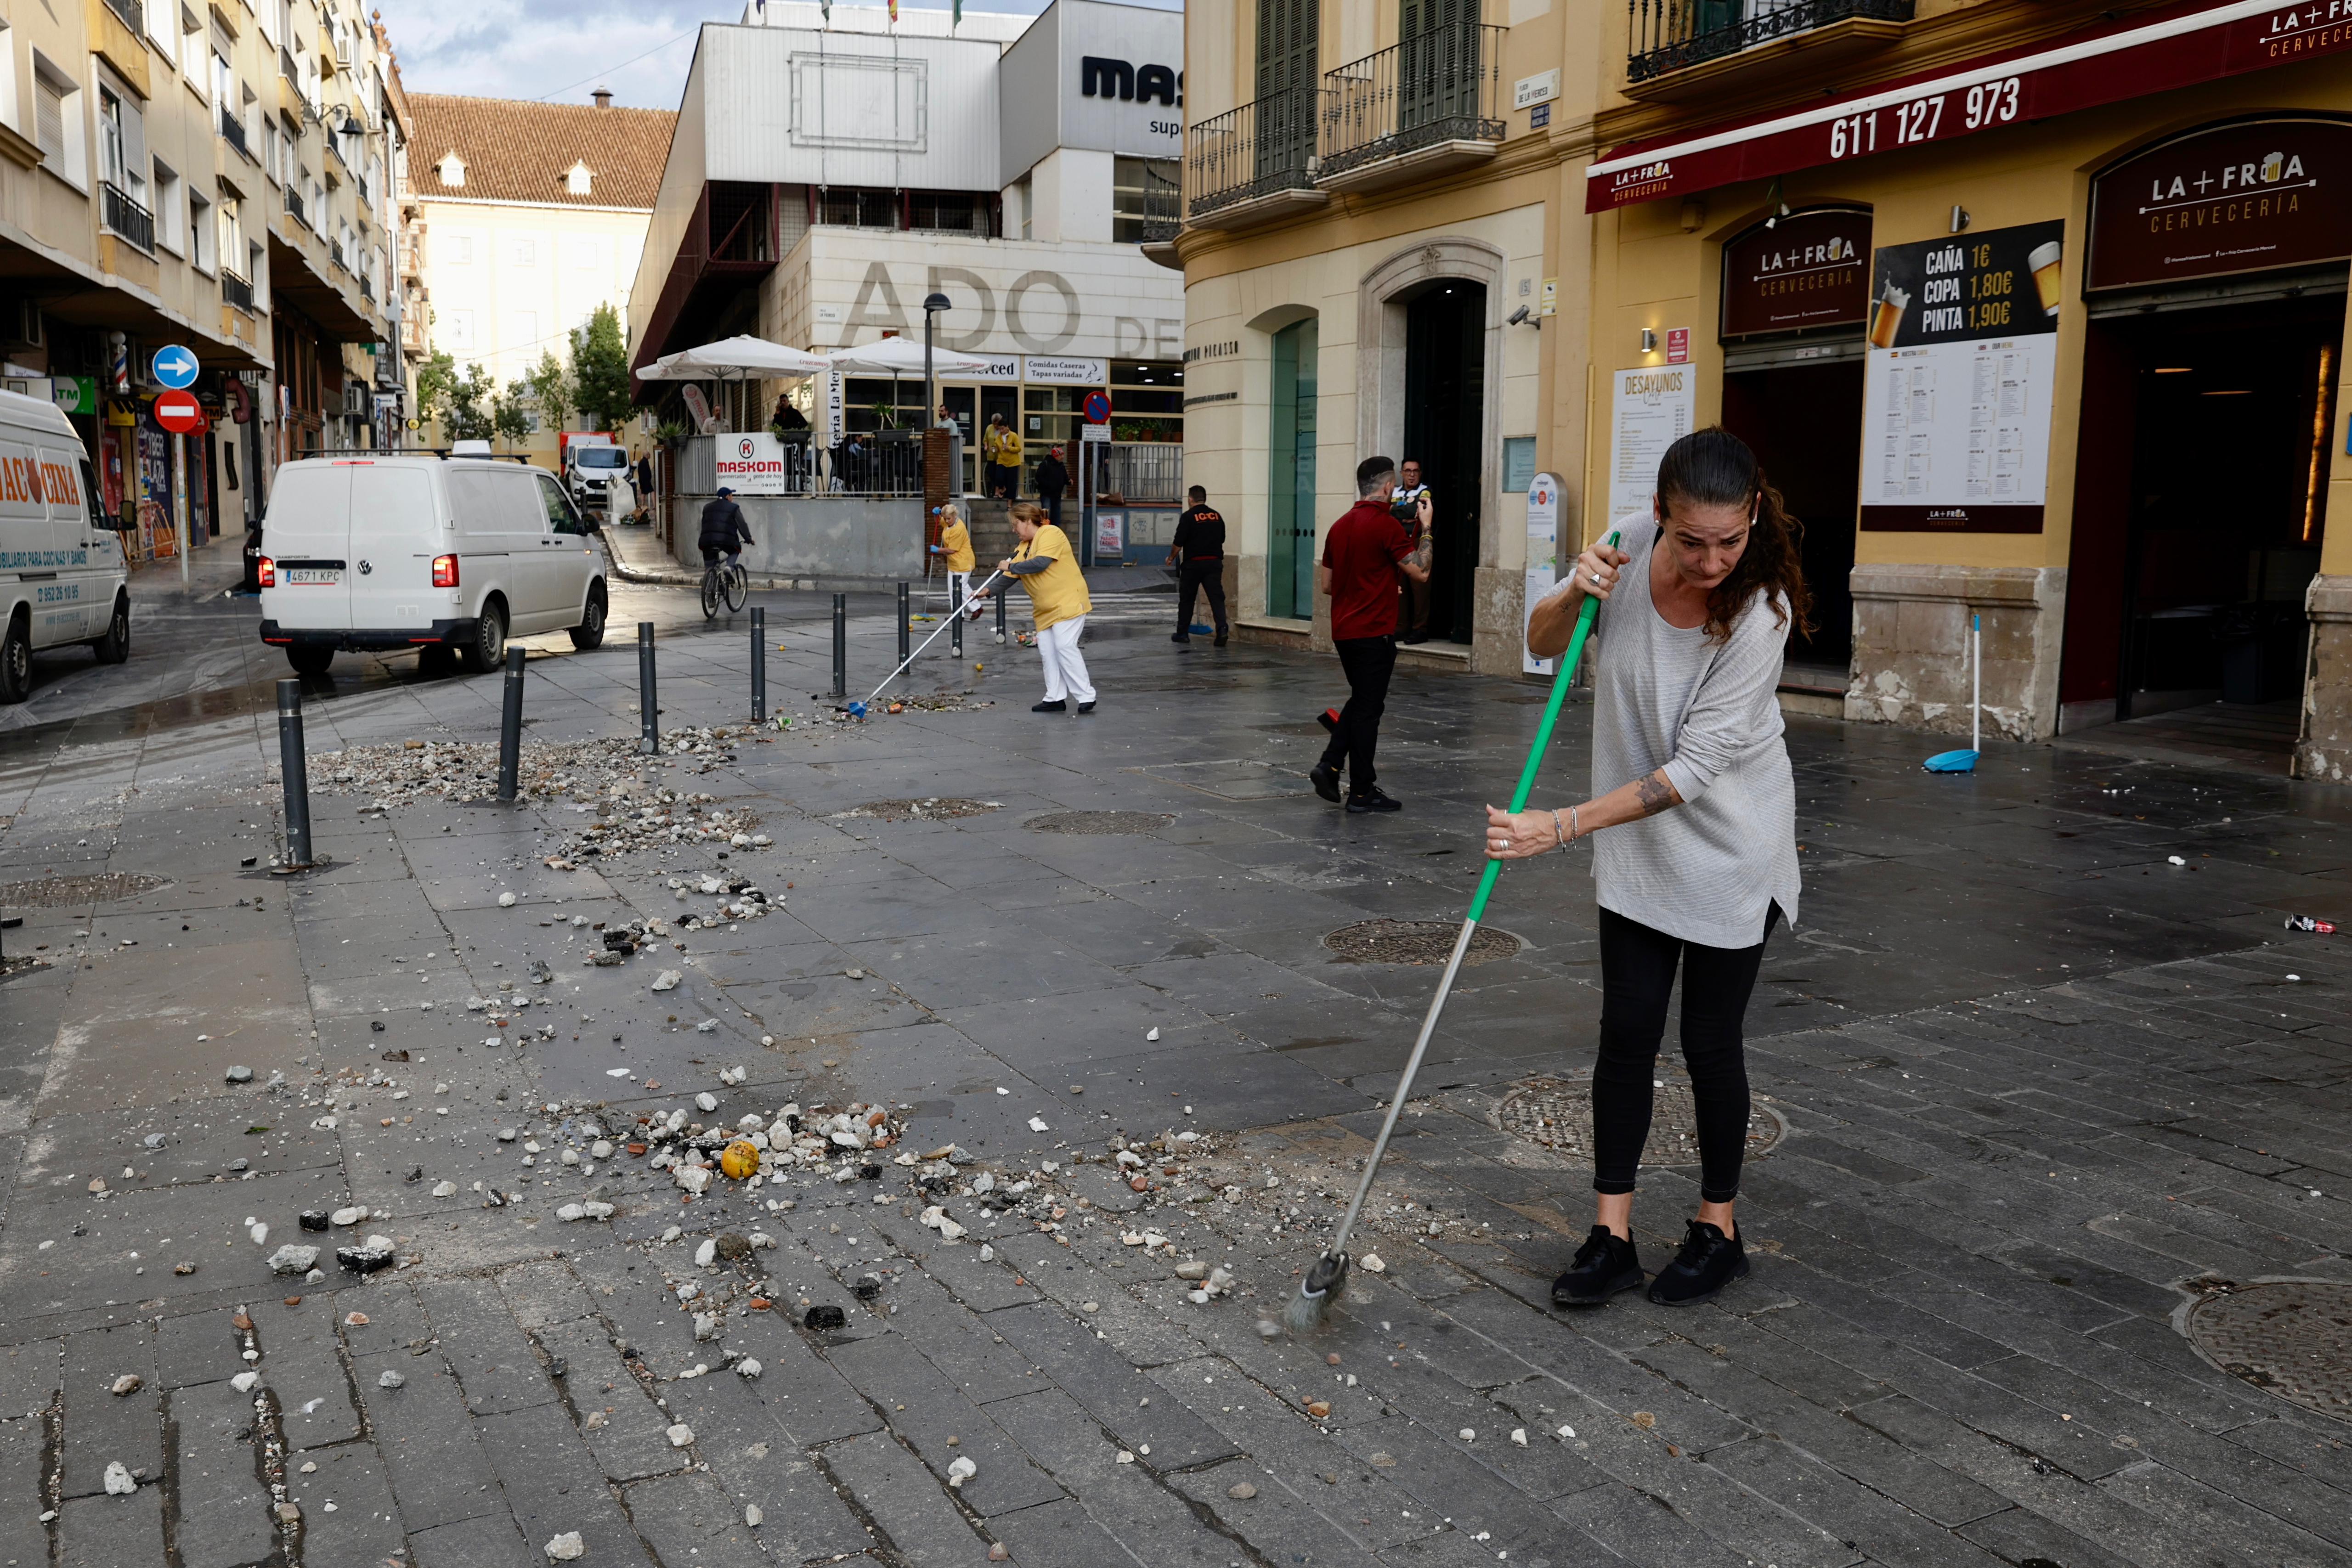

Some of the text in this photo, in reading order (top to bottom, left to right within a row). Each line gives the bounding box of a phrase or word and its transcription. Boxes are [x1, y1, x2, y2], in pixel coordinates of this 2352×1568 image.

[2270, 25, 2352, 57] CERVECE
[1082, 56, 1183, 108] MA
[1518, 86, 1548, 103] DE LA MERCED
[1830, 77, 2020, 158] 611 127 973
[2151, 193, 2298, 233] CERVECERÍA
[1925, 243, 1991, 275] CAÑA 1€
[1761, 270, 1852, 297] CERVECERÍA
[1923, 270, 2013, 304] COPA 1,80€
[1922, 300, 2011, 333] PINTA 1,90€
[1204, 340, 1238, 358] PICASSO
[1031, 370, 1052, 378] Tapas
[1625, 372, 1683, 395] DESAYUNOS
[831, 396, 840, 410] La
[148, 432, 165, 458] YBER
[147, 458, 165, 485] LAZA
[717, 461, 782, 473] MASKOM
[0, 548, 87, 569] BILIARIO PARA COCINAS Y BAÑOS
[292, 571, 339, 581] 4671 KPC
[44, 584, 79, 602] 952 26 10 95
